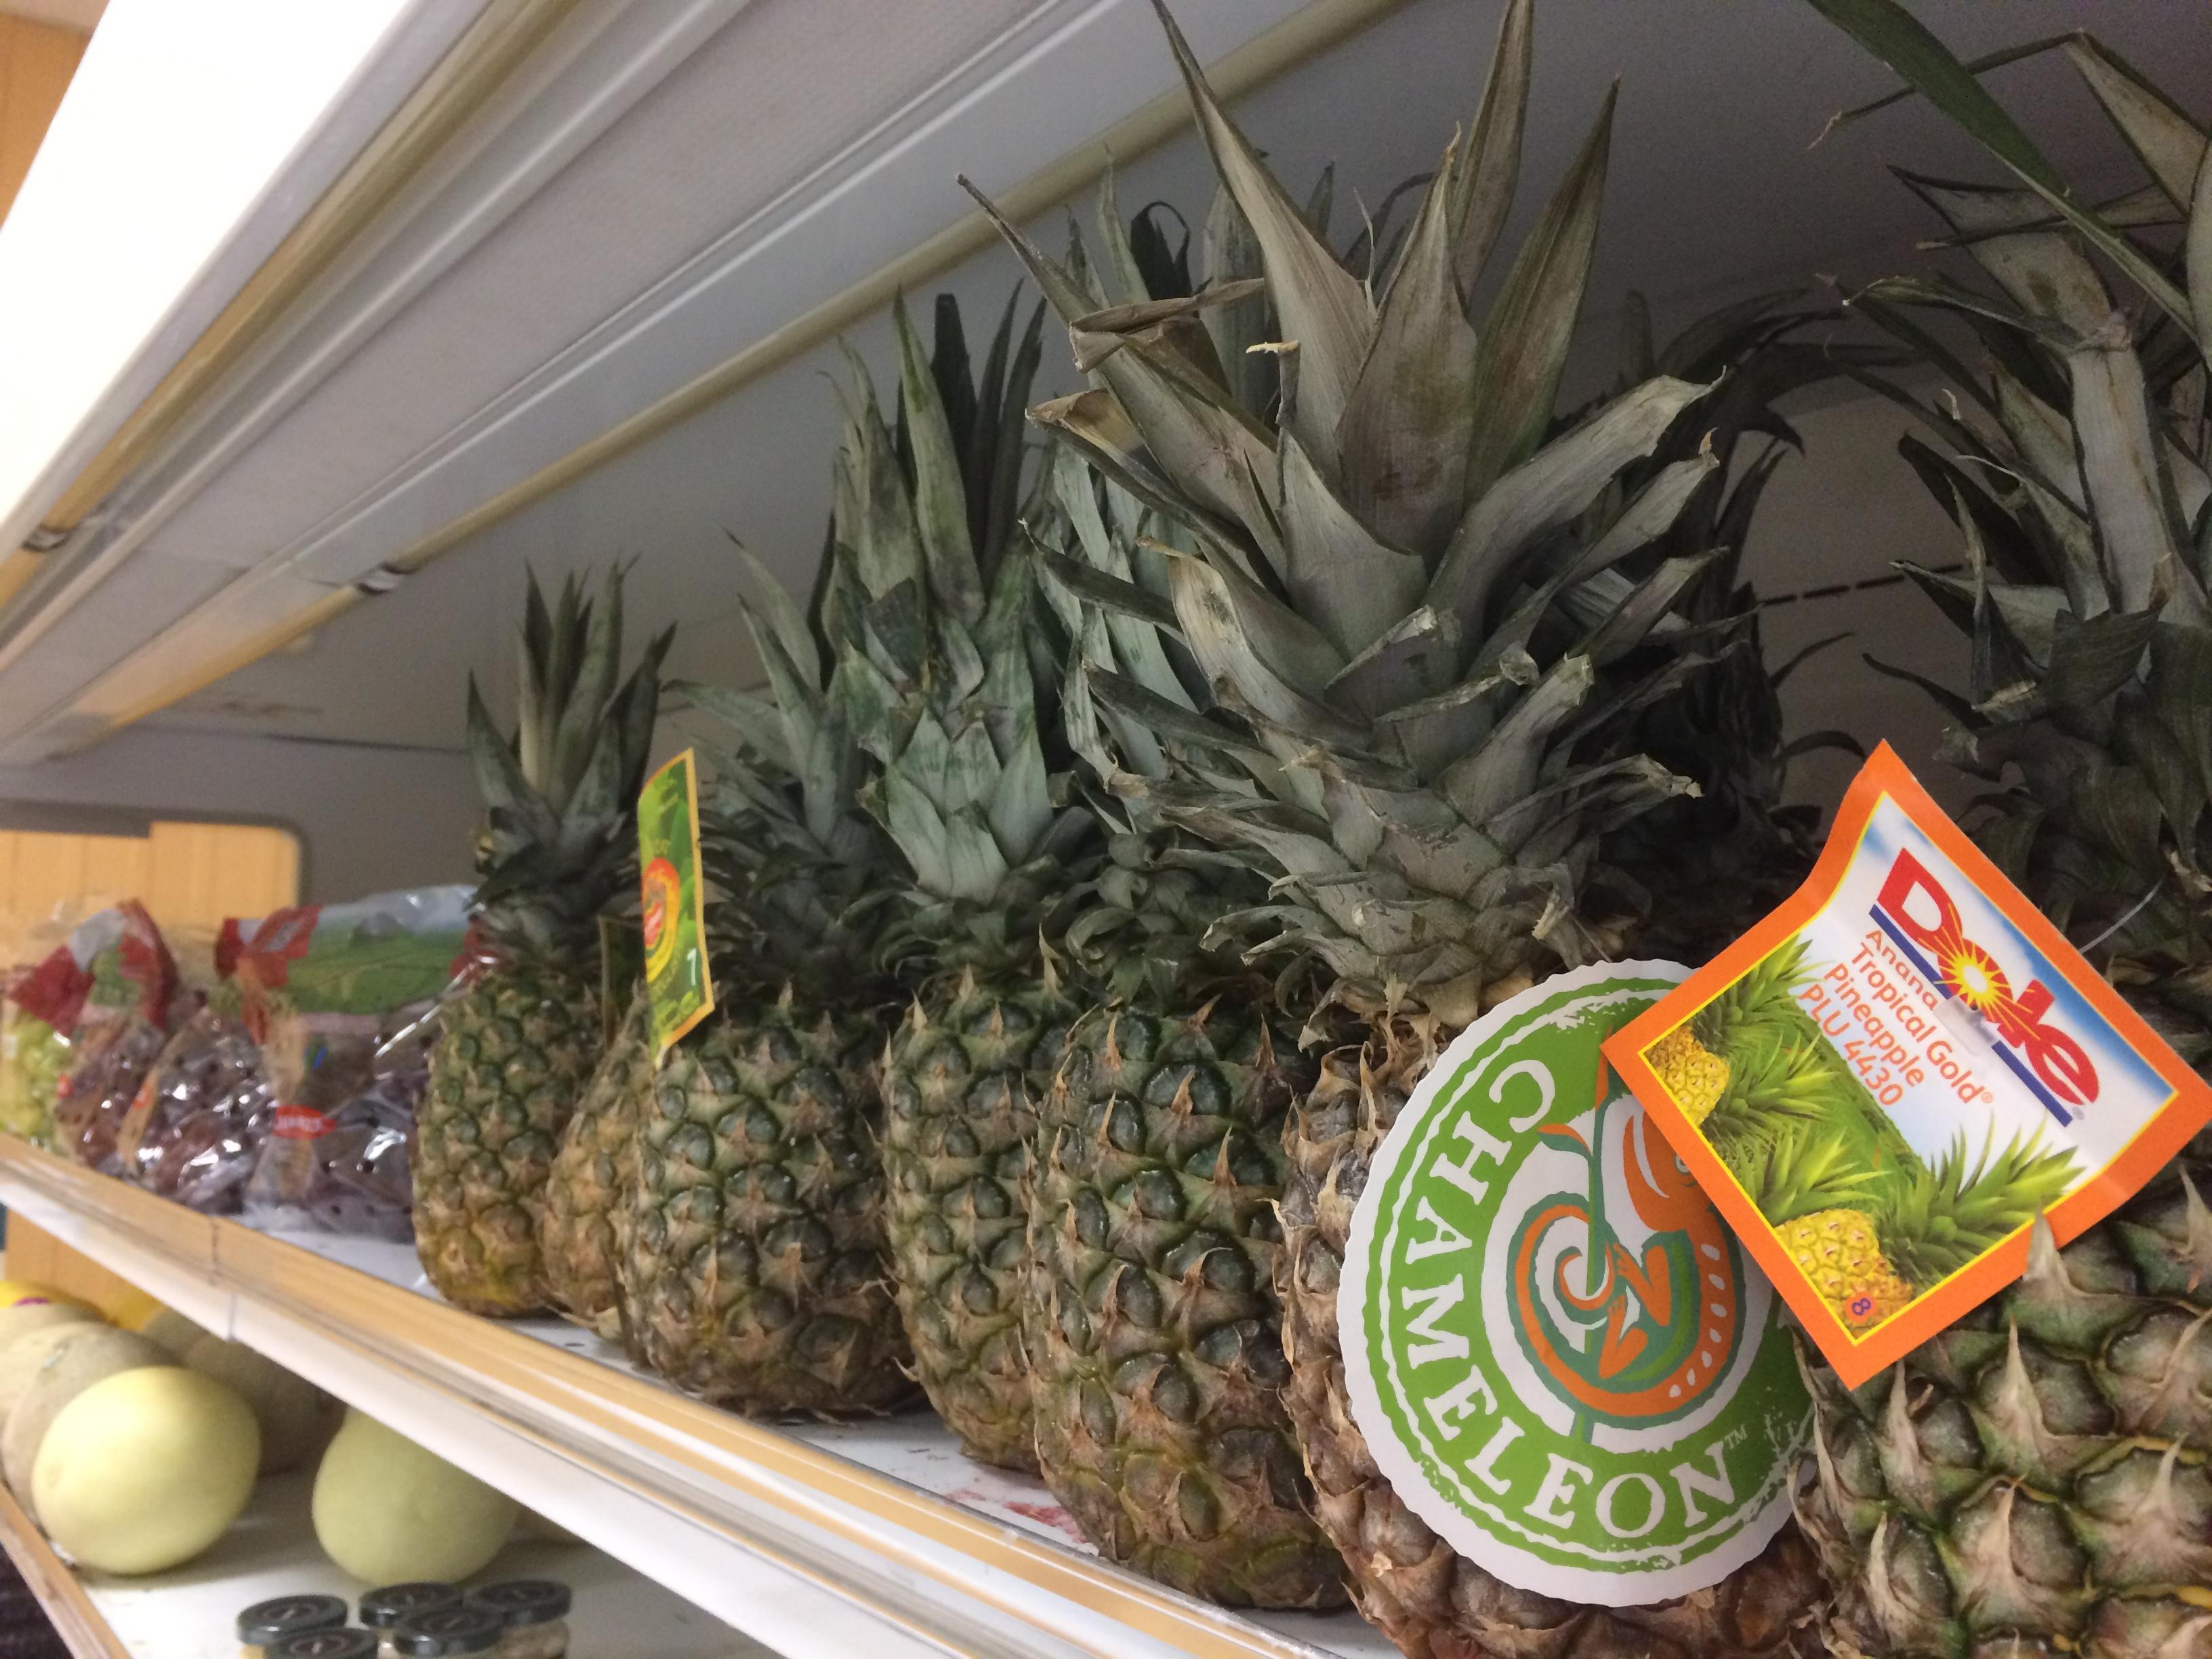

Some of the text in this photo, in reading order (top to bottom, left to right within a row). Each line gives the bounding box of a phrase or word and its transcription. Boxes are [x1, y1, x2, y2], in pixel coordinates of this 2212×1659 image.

[1823, 963, 1925, 1087] Pineapple
[1851, 942, 1938, 1042] Tropical
[1865, 929, 1939, 1011] Anana
[1877, 847, 2100, 1106] Dole
[1799, 983, 1904, 1106] PLU 4430
[1851, 1298, 1871, 1316] 8
